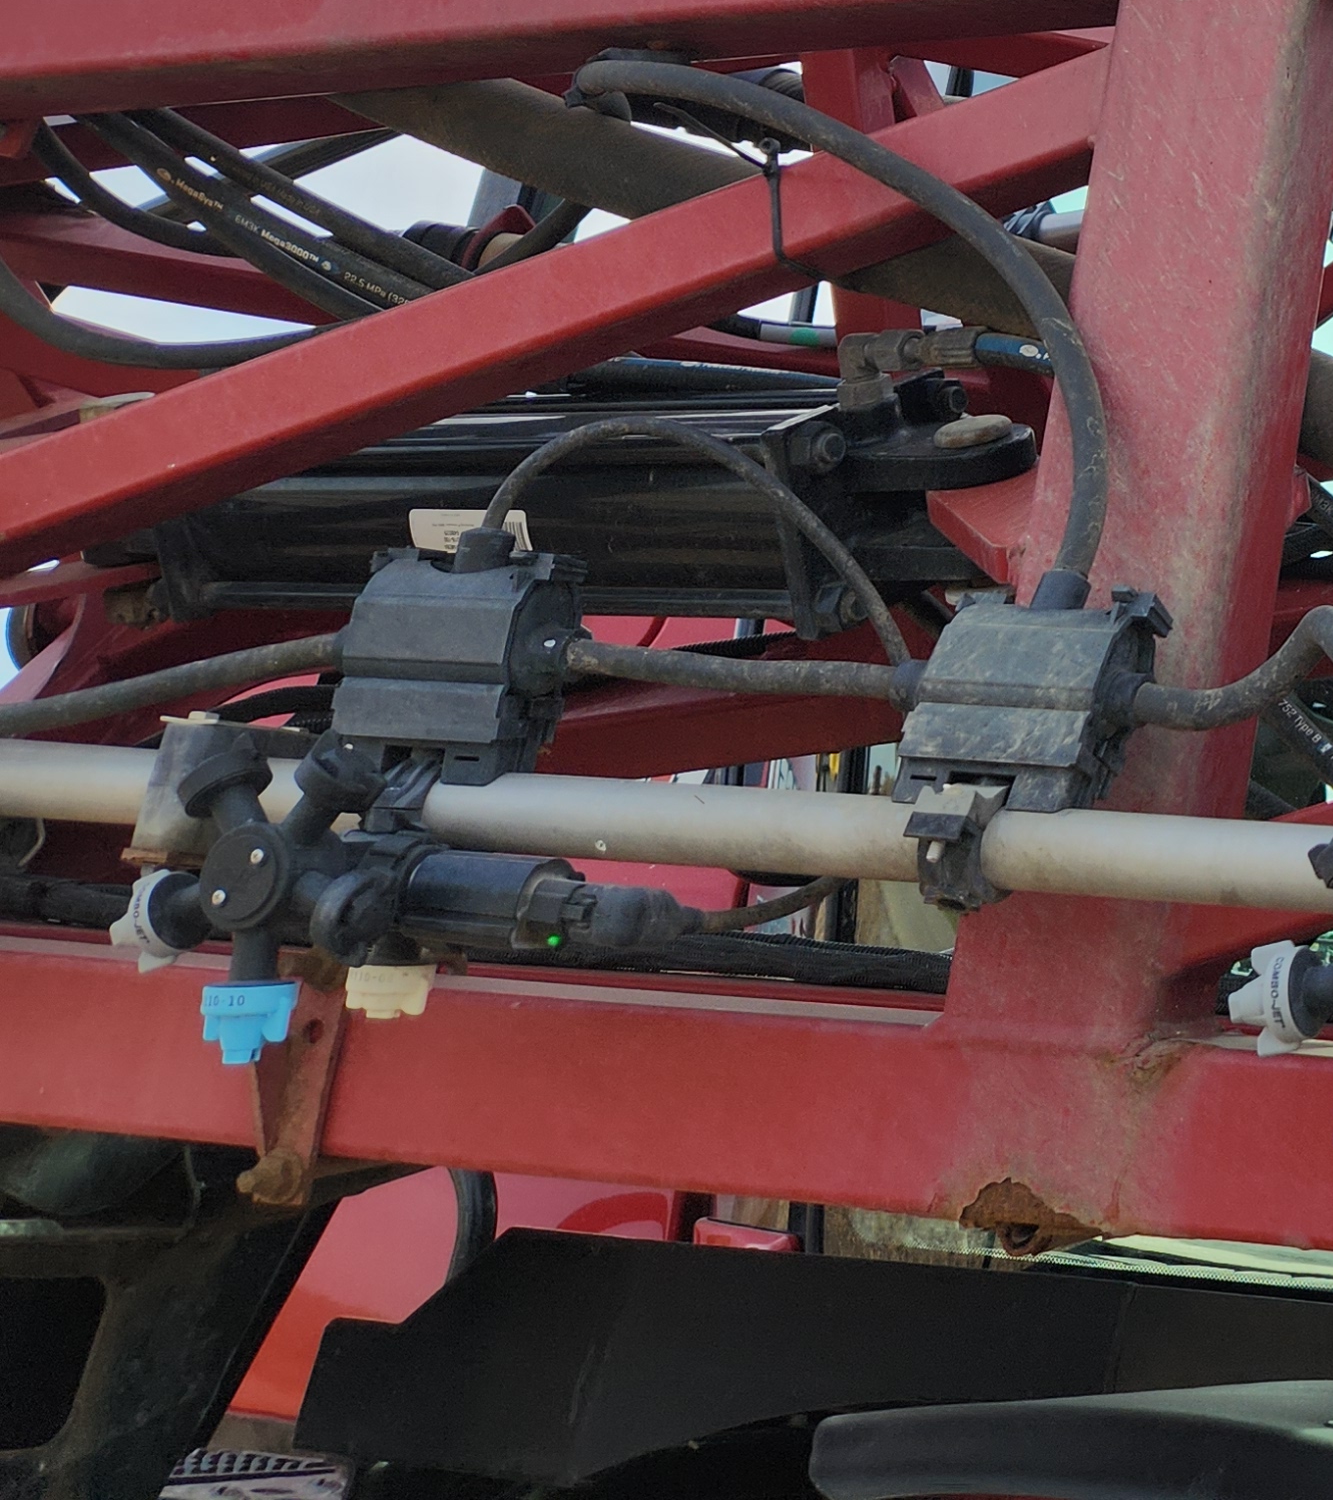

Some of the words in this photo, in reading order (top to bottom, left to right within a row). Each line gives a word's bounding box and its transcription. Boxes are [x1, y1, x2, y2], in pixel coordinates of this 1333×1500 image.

[1278, 698, 1298, 718] 752
[1294, 713, 1315, 736] Type
[1311, 733, 1323, 744] B
[1269, 956, 1286, 1030] COMBO-JET
